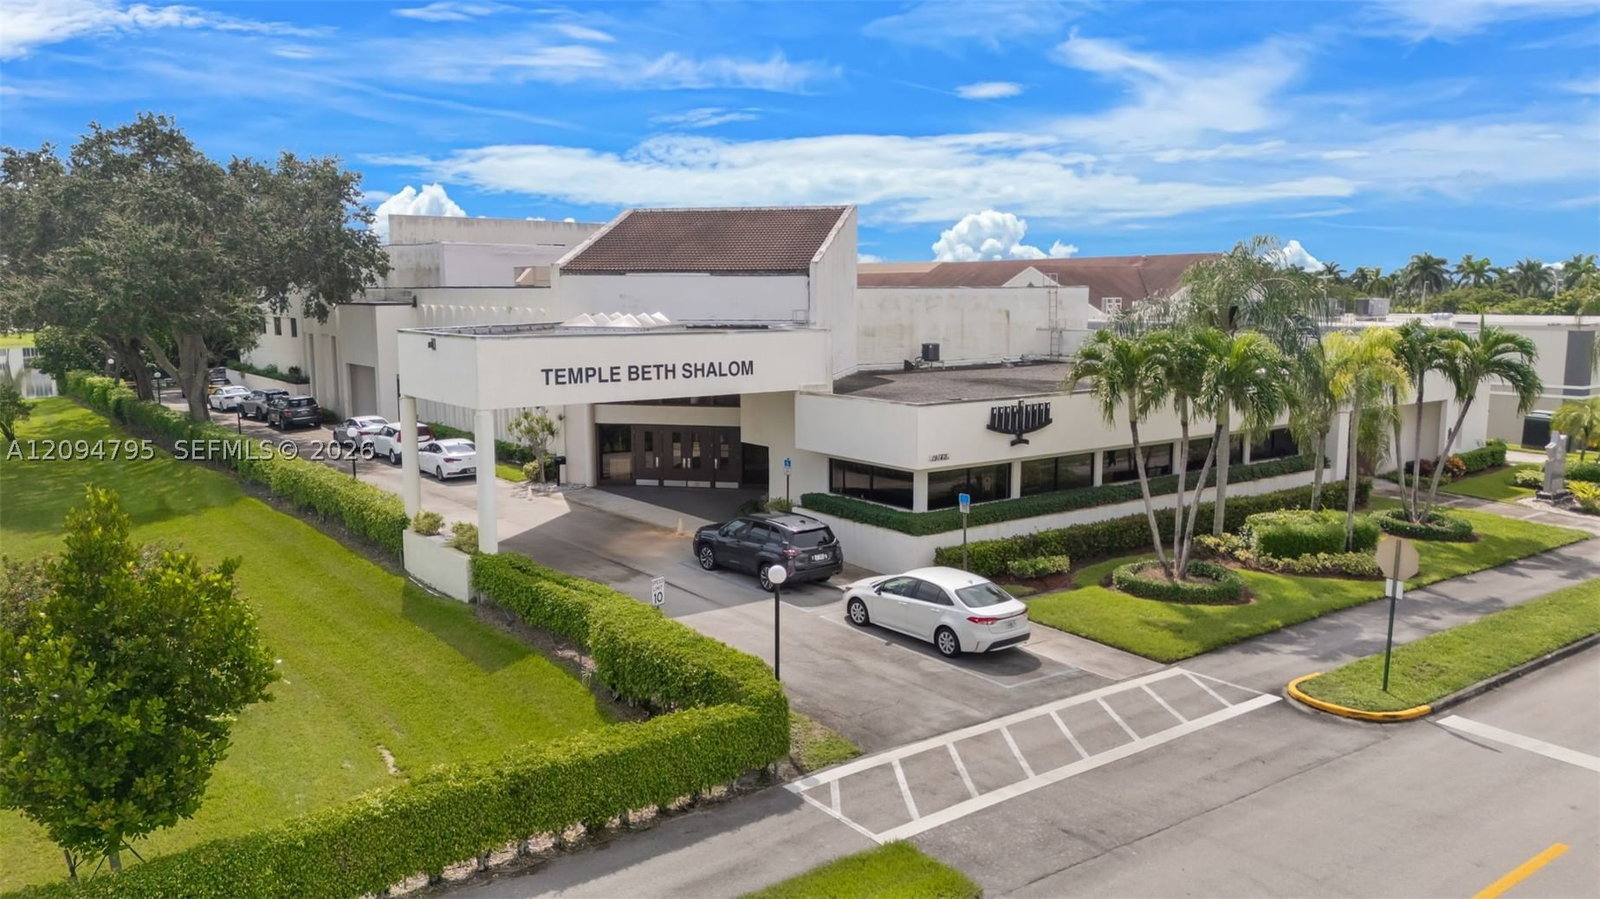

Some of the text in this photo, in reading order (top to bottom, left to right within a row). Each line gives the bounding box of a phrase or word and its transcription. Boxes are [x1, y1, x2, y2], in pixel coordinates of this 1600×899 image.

[541, 360, 754, 385] TEMPLE BETH SHALOM
[654, 592, 663, 603] 10
